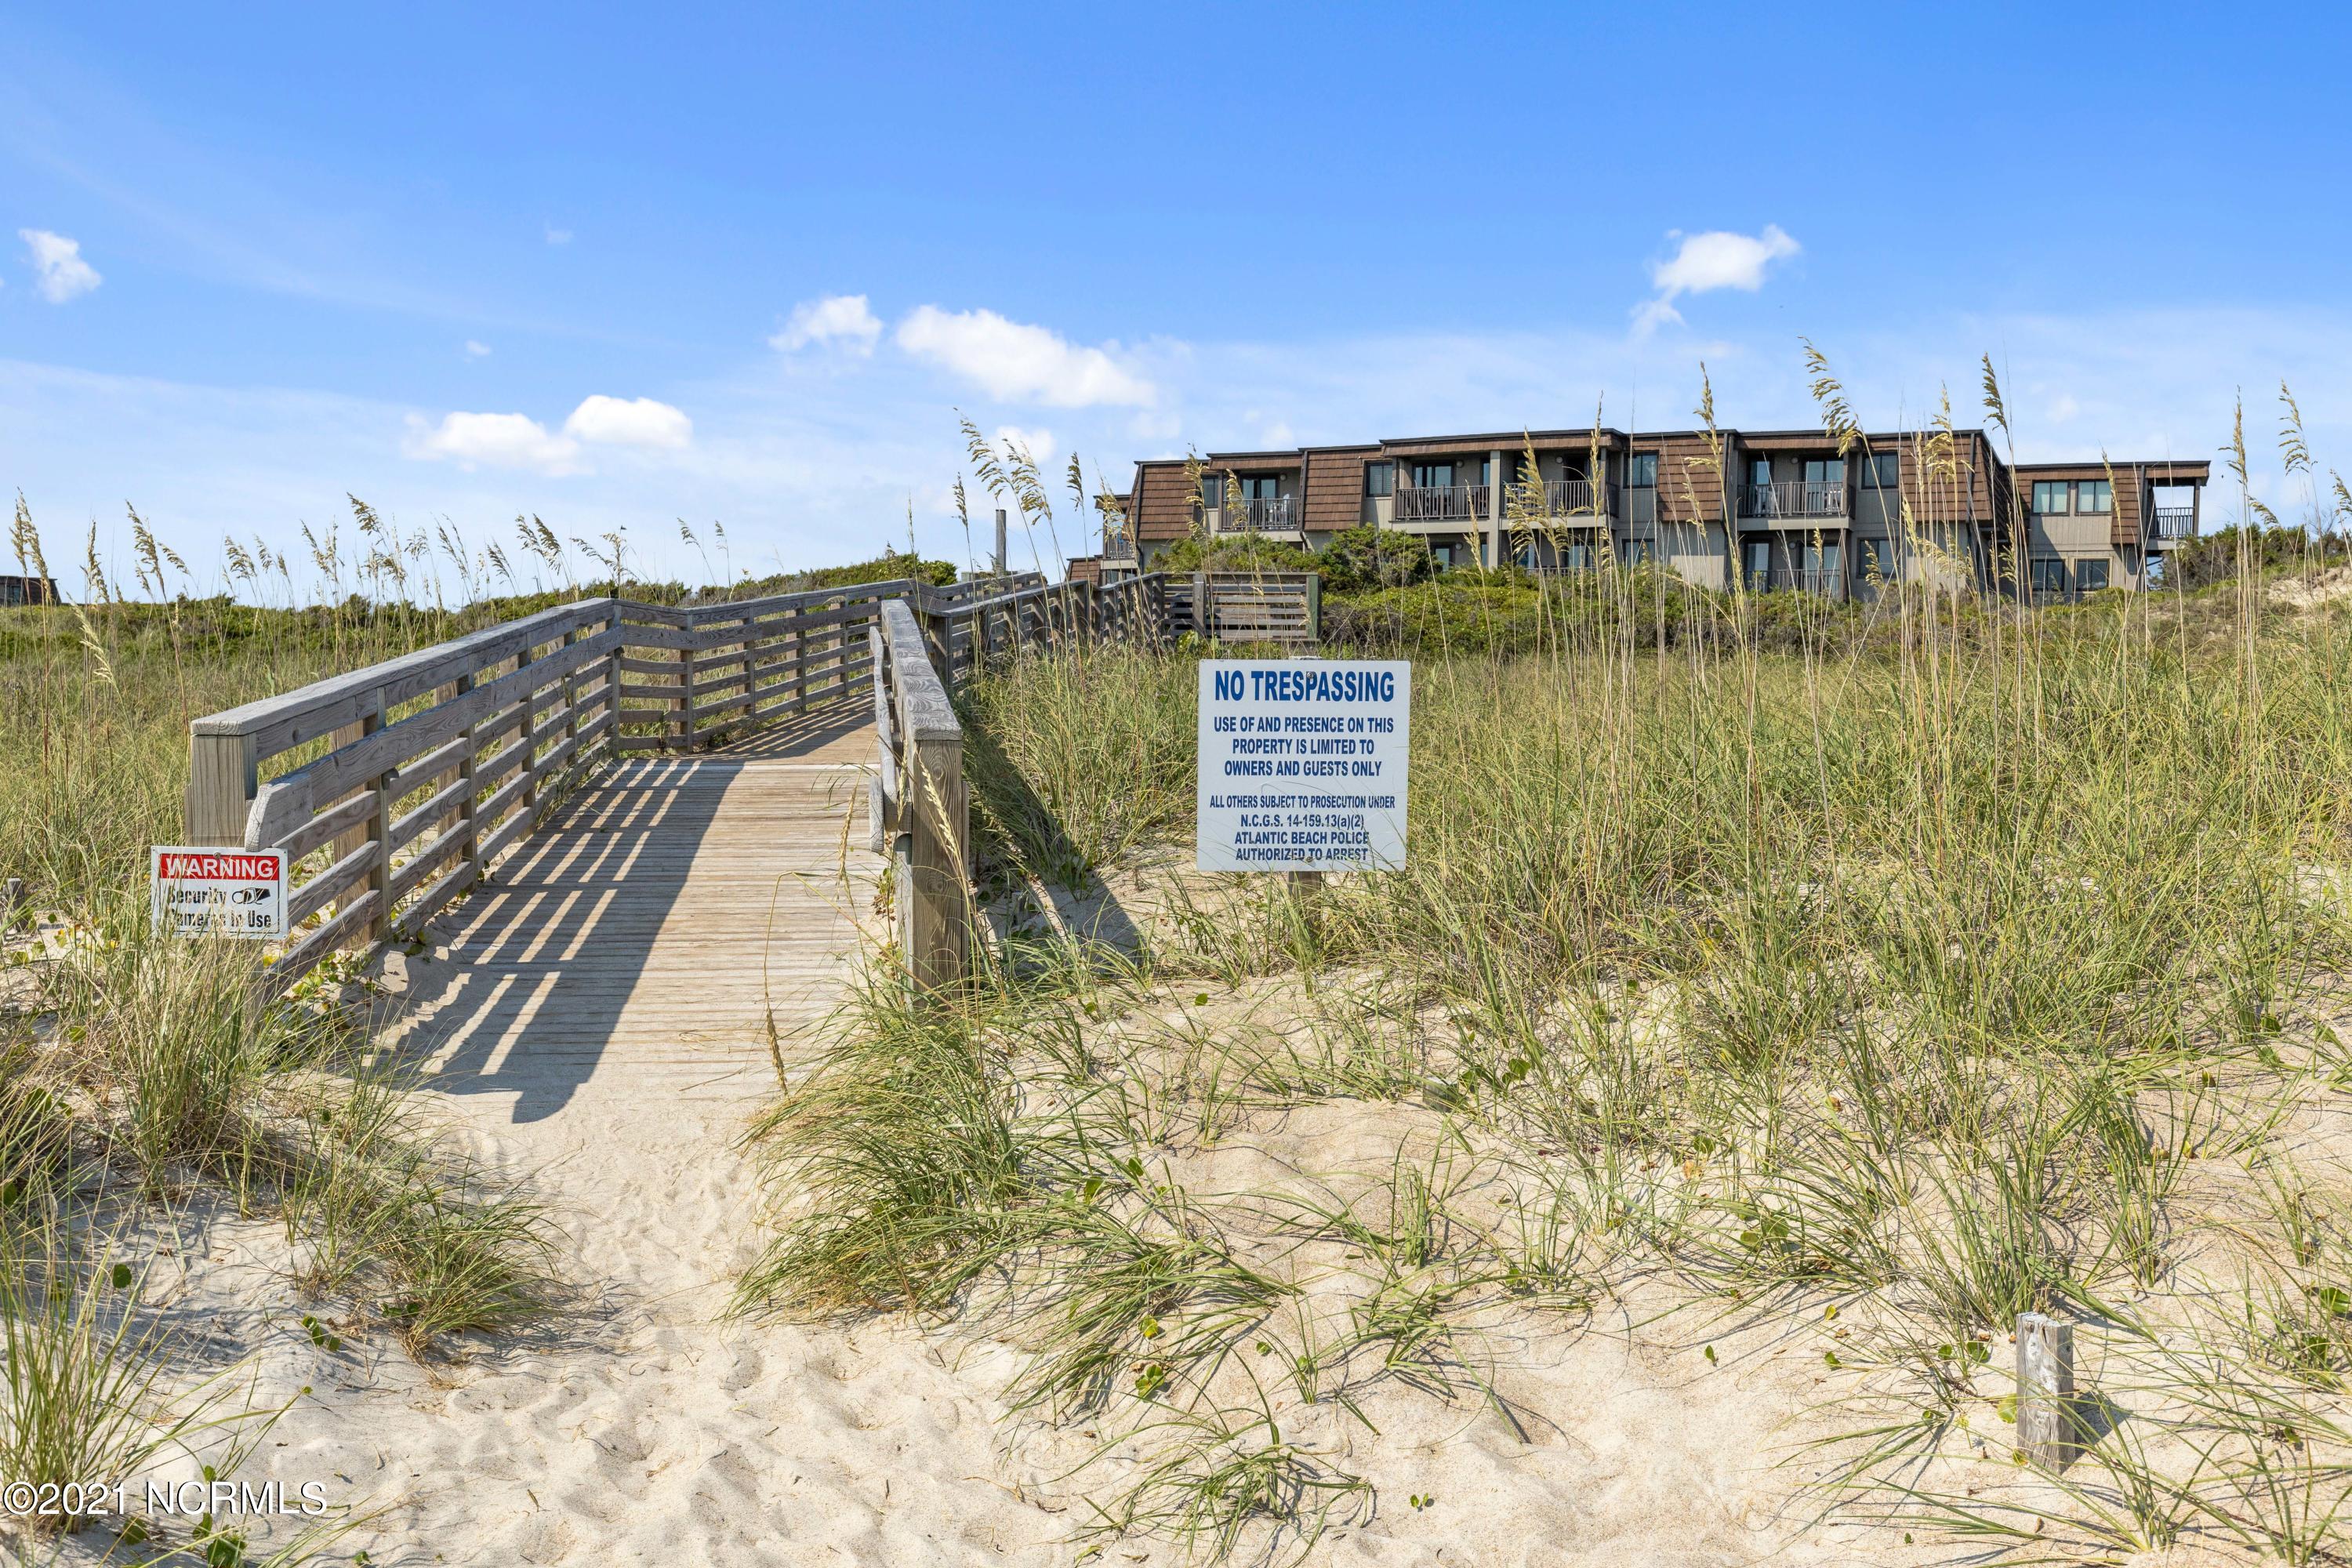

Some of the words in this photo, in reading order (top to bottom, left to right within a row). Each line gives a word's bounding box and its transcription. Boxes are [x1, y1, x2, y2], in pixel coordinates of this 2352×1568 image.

[1215, 670, 1244, 701] NO
[1251, 670, 1394, 702] TRESPASSING
[1214, 717, 1236, 732] USE
[1240, 717, 1254, 732] OF
[1258, 717, 1281, 732] AND
[1285, 717, 1344, 733] PRESENCE
[1348, 717, 1364, 733] ON
[1367, 717, 1394, 734] THIS
[1232, 739, 1293, 754] PROPERTY
[1296, 739, 1307, 755] IS
[1310, 739, 1356, 755] LIMITED
[1359, 739, 1374, 755] TO
[1224, 760, 1272, 776] OWNERS
[1276, 760, 1300, 776] AND
[1303, 760, 1348, 776] GUESTS
[1352, 760, 1382, 776] ONLY
[1210, 795, 1225, 808] ALL
[1226, 795, 1258, 808] OTHERS
[1260, 795, 1295, 808] SUBJECT
[1298, 795, 1308, 808] TO
[1311, 795, 1366, 808] PROSECUTION
[1368, 795, 1396, 809] UNDER
[1240, 814, 1283, 827] N.C.G.S.
[1287, 814, 1364, 831] 14-159.13(a)(2)
[1235, 831, 1288, 844] ATLANTIC
[1291, 831, 1327, 844] BEACH
[1330, 831, 1370, 844] POLICE
[1236, 848, 1305, 861] AUTHORIZED
[1308, 848, 1323, 861] TO
[1326, 848, 1369, 861] ARREST
[165, 857, 274, 878] WARNING
[248, 910, 271, 927] Use
